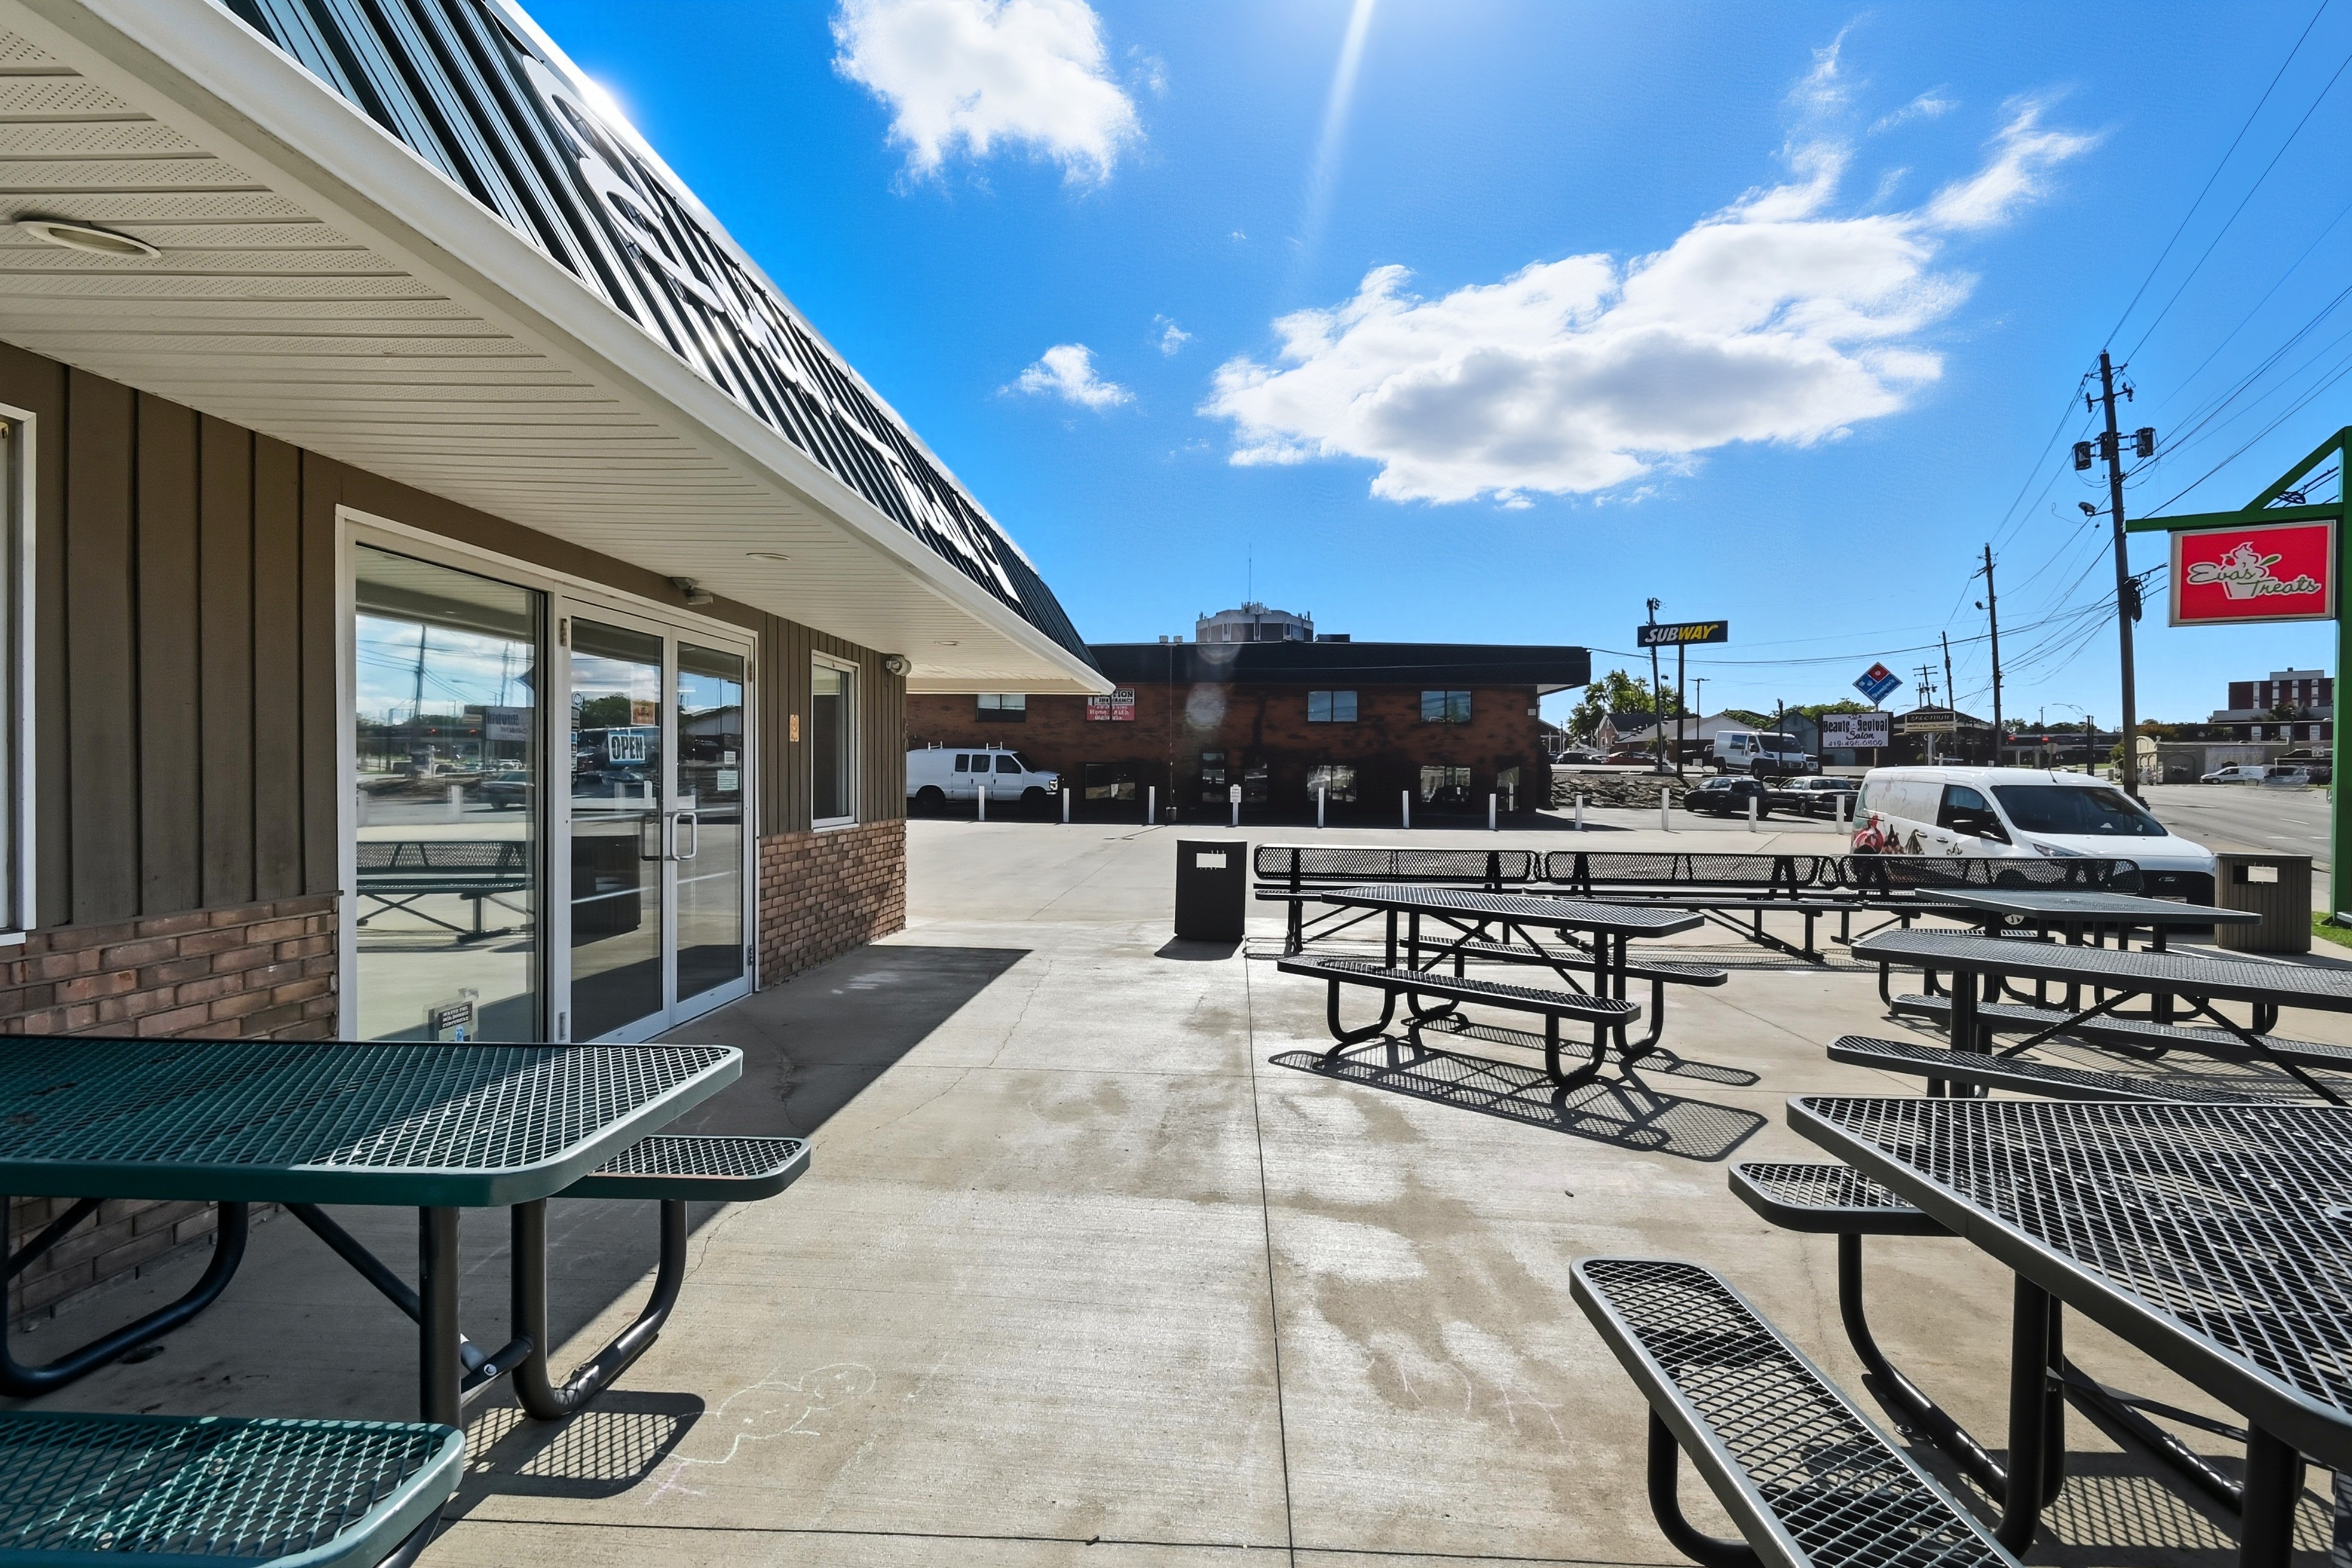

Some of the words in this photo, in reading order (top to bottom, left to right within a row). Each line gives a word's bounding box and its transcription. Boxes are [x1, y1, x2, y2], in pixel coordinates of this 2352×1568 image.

[2189, 562, 2256, 583] Eva's
[2237, 576, 2320, 596] Treats
[1644, 624, 1719, 642] SUBWAY
[1846, 730, 1875, 740] Salon
[611, 736, 644, 760] OPEN
